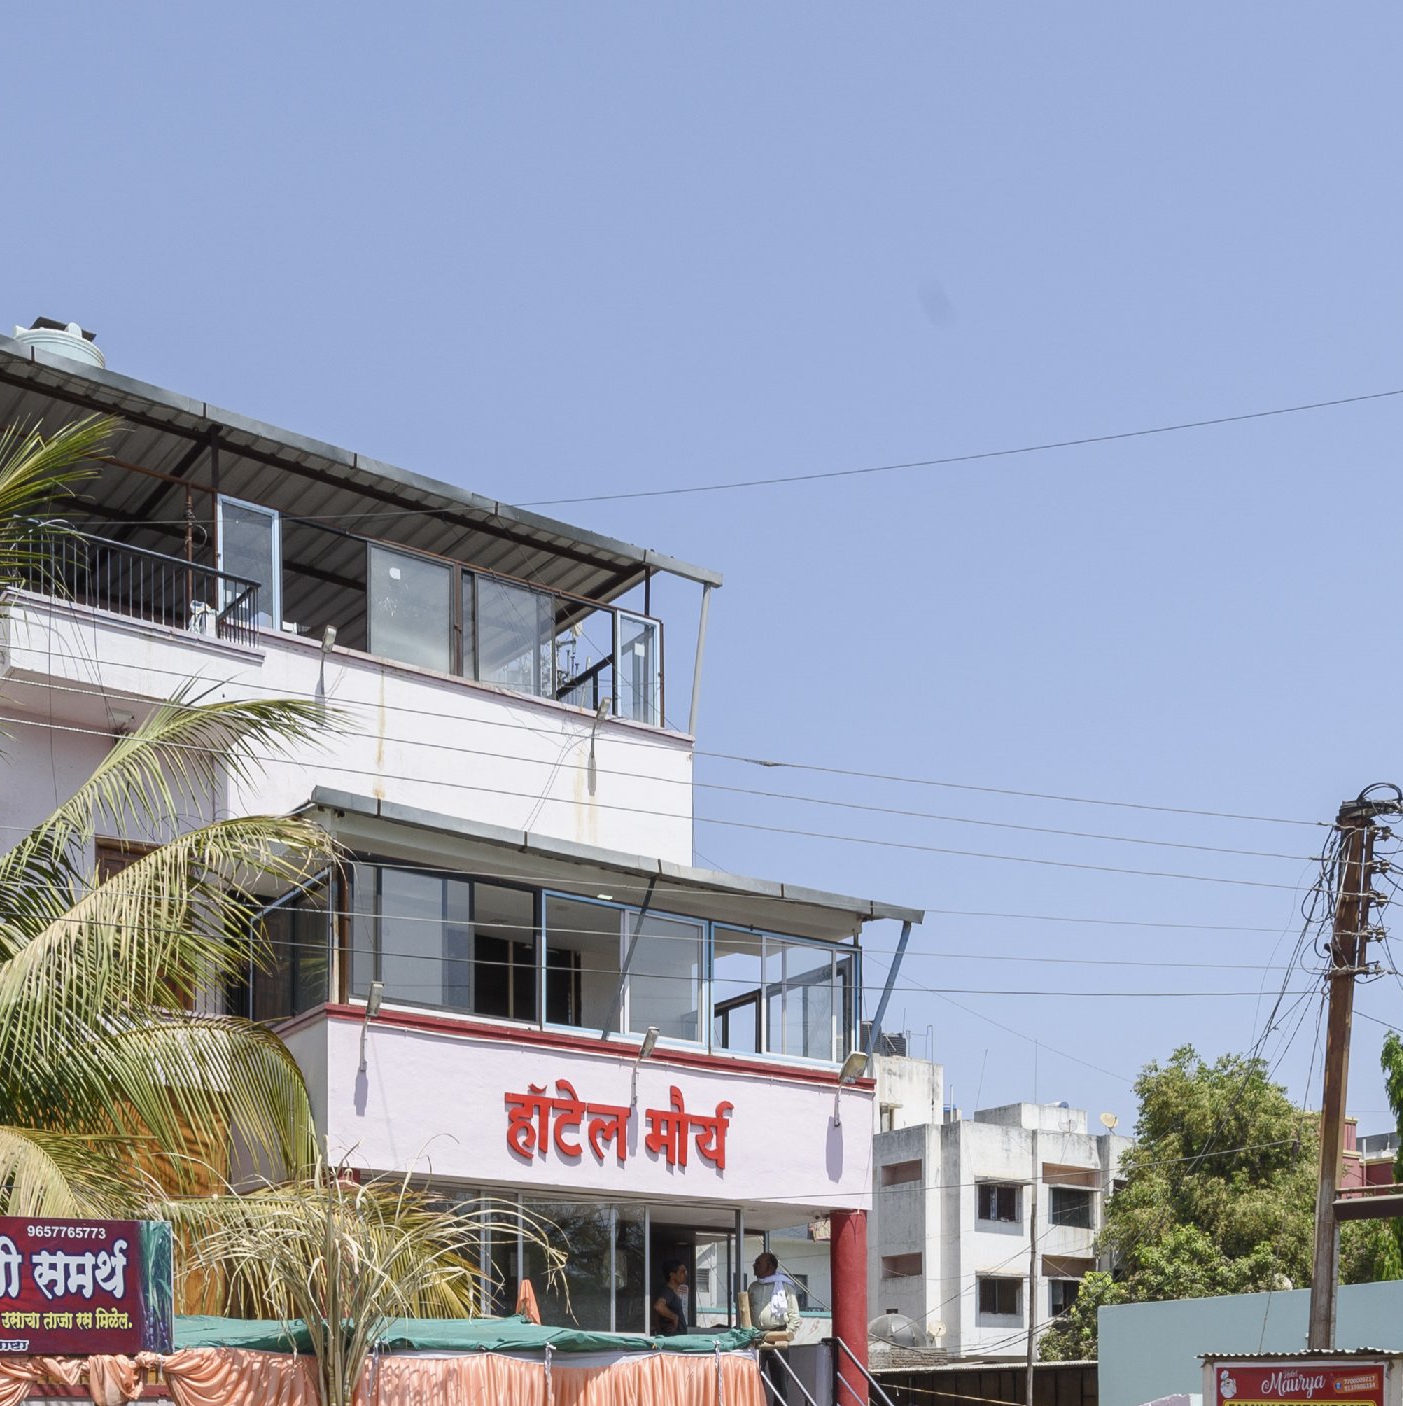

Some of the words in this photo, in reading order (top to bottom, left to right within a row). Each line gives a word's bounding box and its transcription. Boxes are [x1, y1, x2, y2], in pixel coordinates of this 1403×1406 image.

[504, 1079, 631, 1161] हॉटेल
[27, 1225, 107, 1239] 9657765773
[32, 1239, 128, 1299] समर्थ
[1, 1312, 40, 1329] उसाचा
[43, 1312, 73, 1329] ताजा
[76, 1312, 93, 1329] रस
[1261, 1371, 1326, 1399] Maurya
